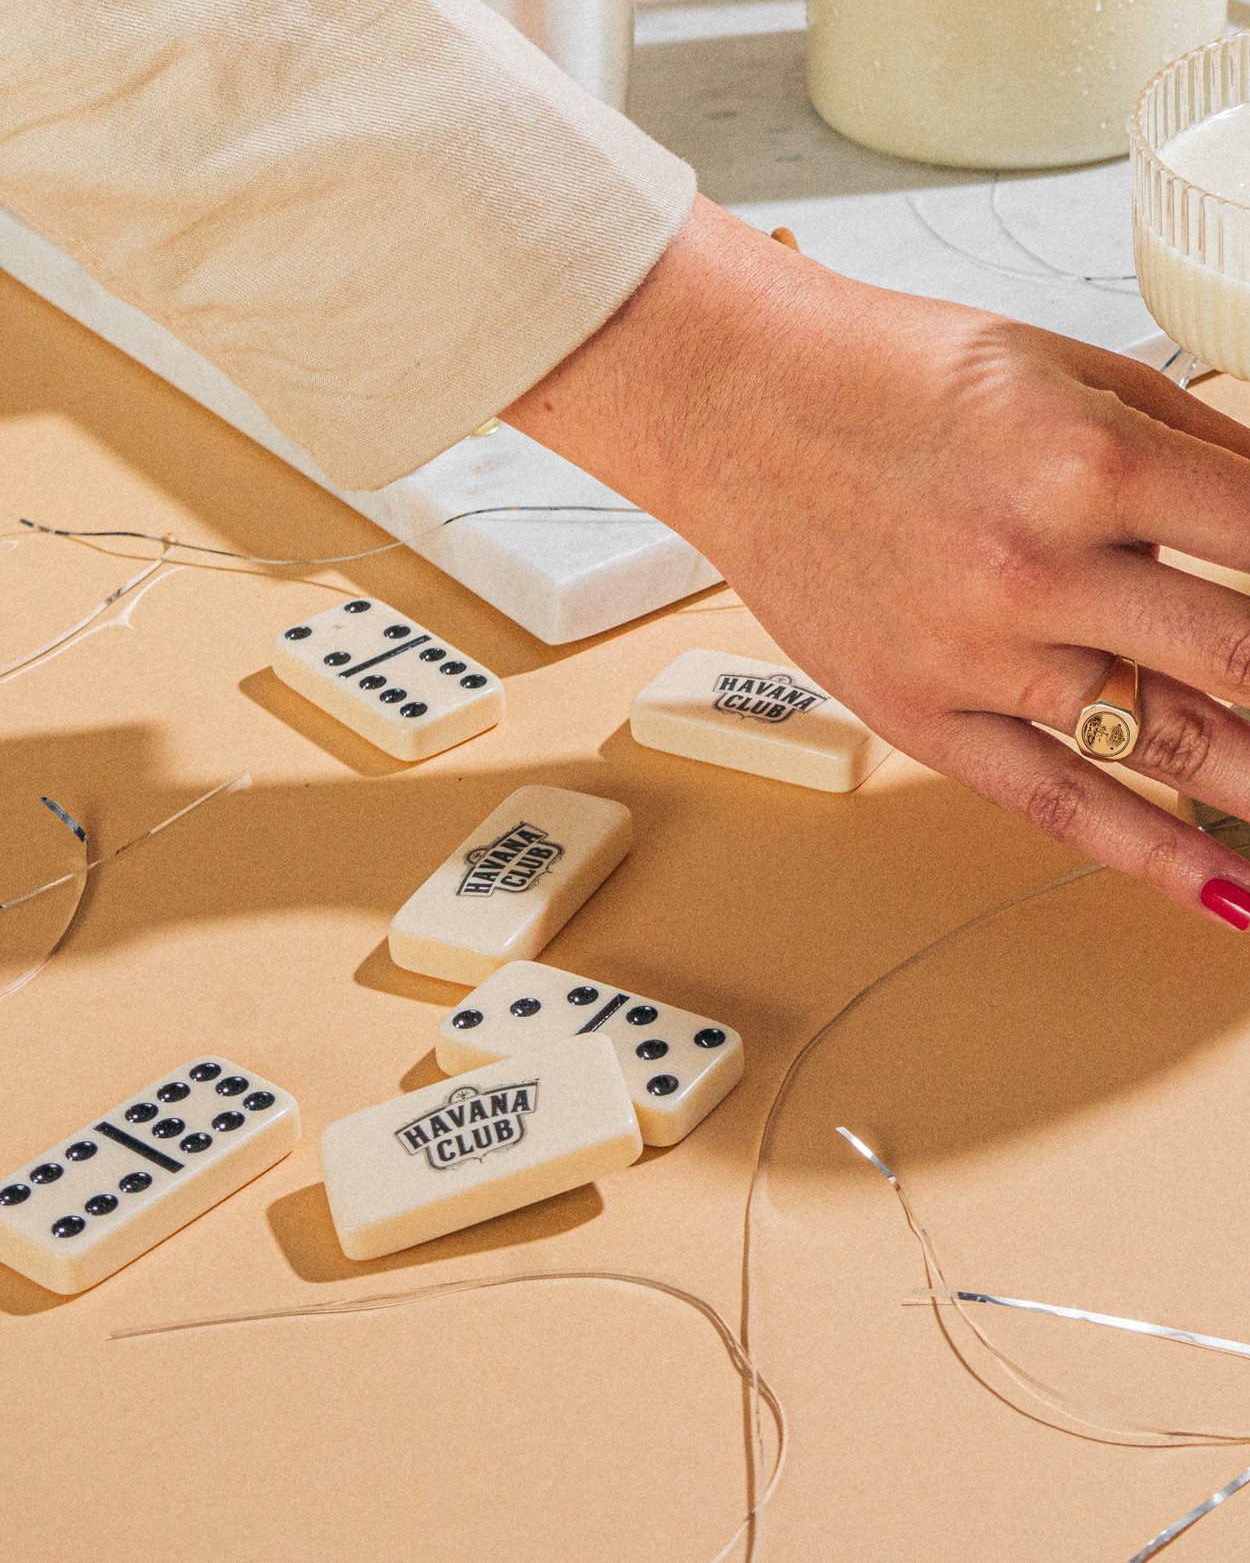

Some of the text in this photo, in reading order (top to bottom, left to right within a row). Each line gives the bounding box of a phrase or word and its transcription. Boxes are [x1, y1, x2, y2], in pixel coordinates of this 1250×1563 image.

[719, 678, 816, 711] HAVANA
[723, 694, 786, 718] CLUB
[463, 830, 543, 894] HAVANA
[500, 846, 554, 887] CLUB
[403, 1089, 531, 1150] HAVANA
[437, 1119, 514, 1162] CLUB
